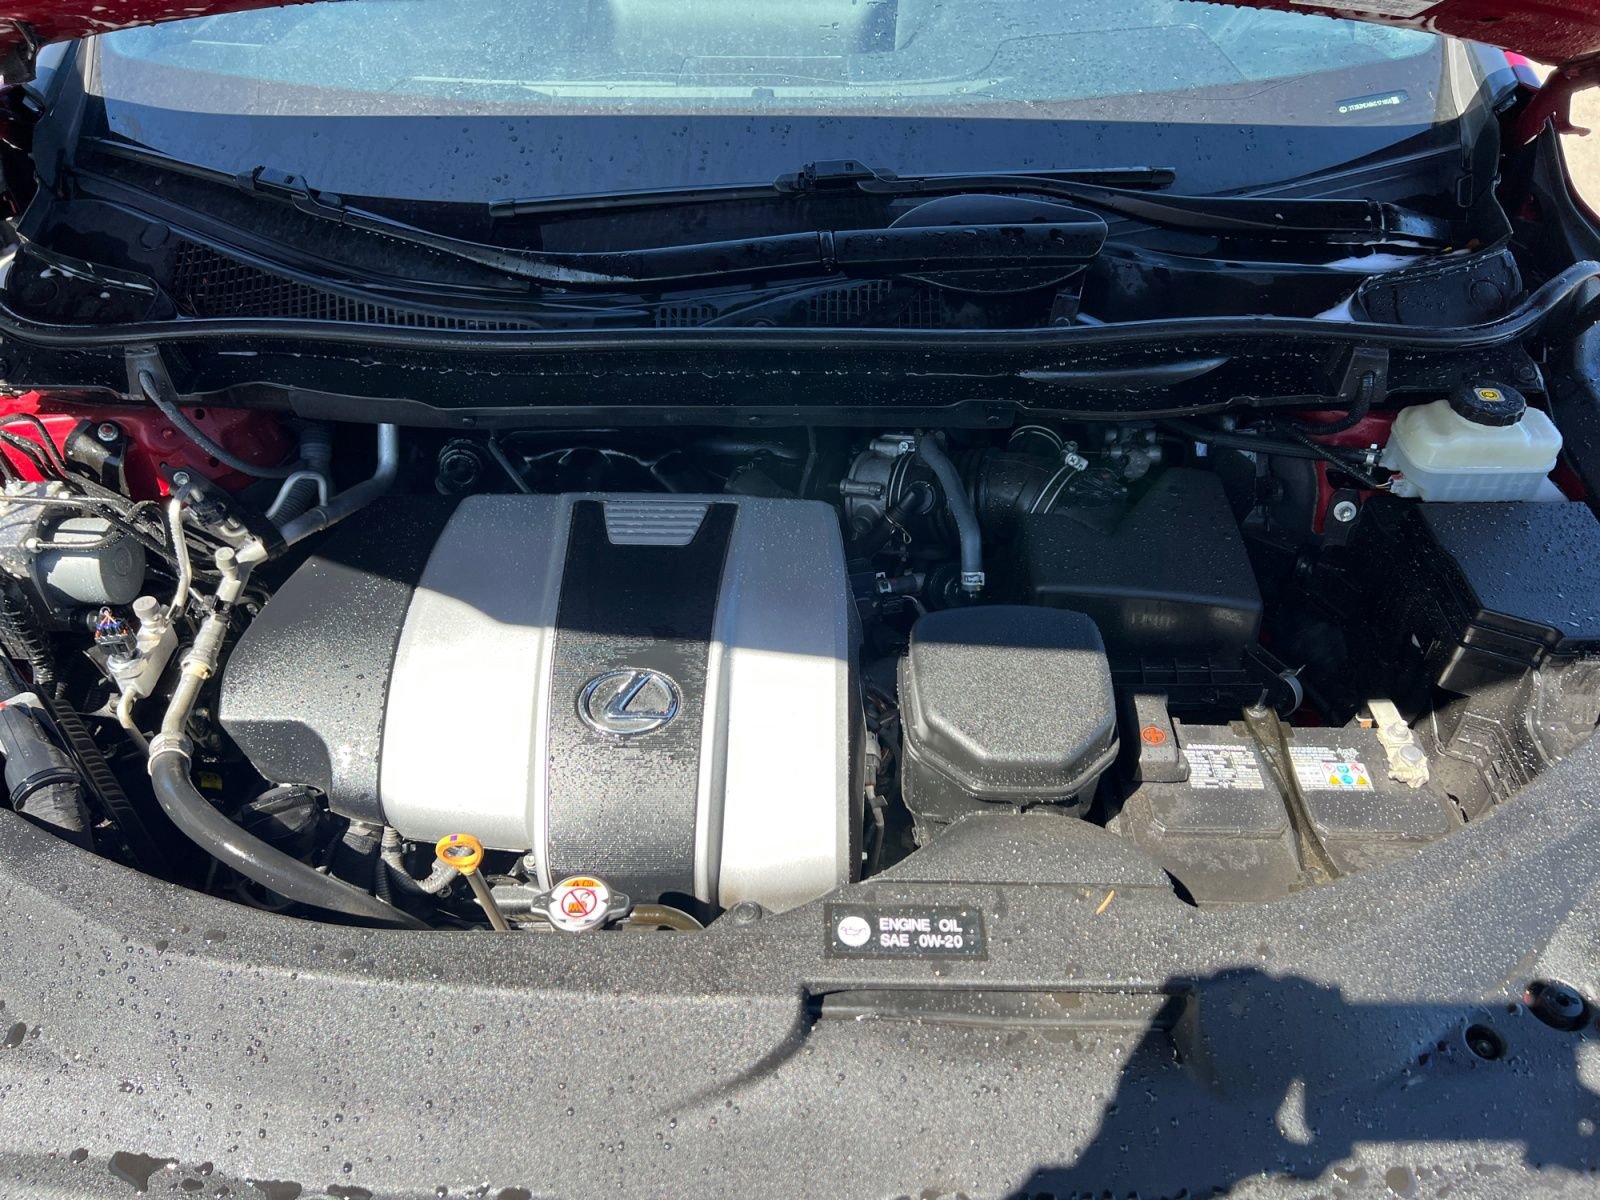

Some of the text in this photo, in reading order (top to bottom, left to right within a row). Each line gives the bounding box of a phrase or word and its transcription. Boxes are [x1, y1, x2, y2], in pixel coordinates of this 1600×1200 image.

[879, 918, 963, 932] ENGINE OIL
[880, 933, 963, 948] SAE 0W-20
